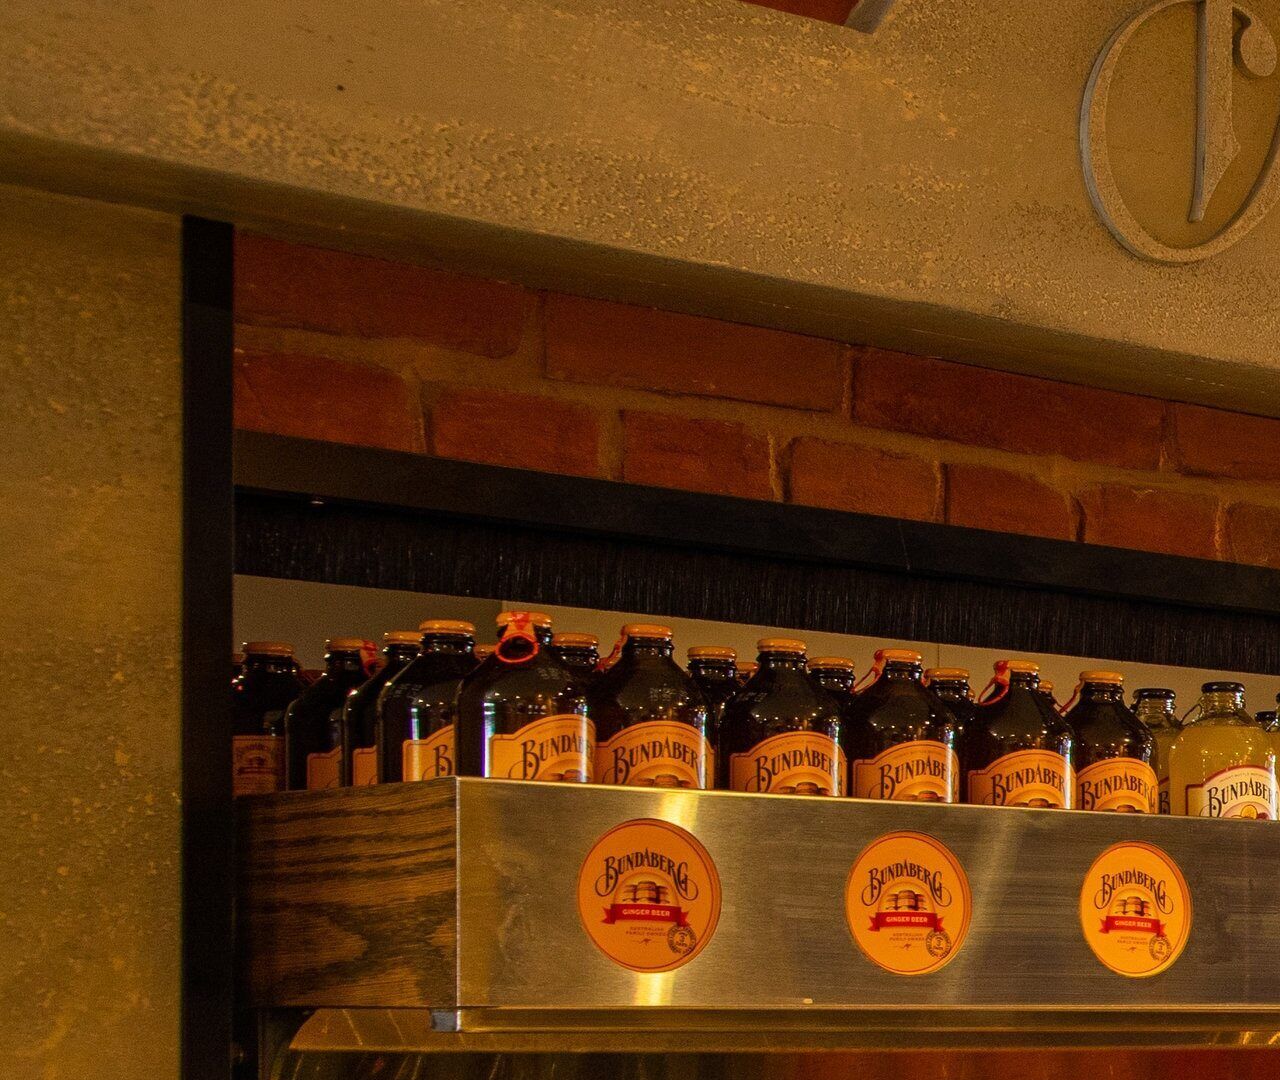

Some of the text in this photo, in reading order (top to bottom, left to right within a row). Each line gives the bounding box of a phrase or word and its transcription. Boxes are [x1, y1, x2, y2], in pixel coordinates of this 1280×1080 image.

[981, 763, 1068, 806] BUNDABER
[1201, 777, 1279, 819] BUNDABE
[595, 848, 699, 901] BUNDABERG
[861, 859, 952, 907] BUNDABERG
[1094, 868, 1173, 914] BUNDABERG
[622, 908, 671, 917] GINGER BEER
